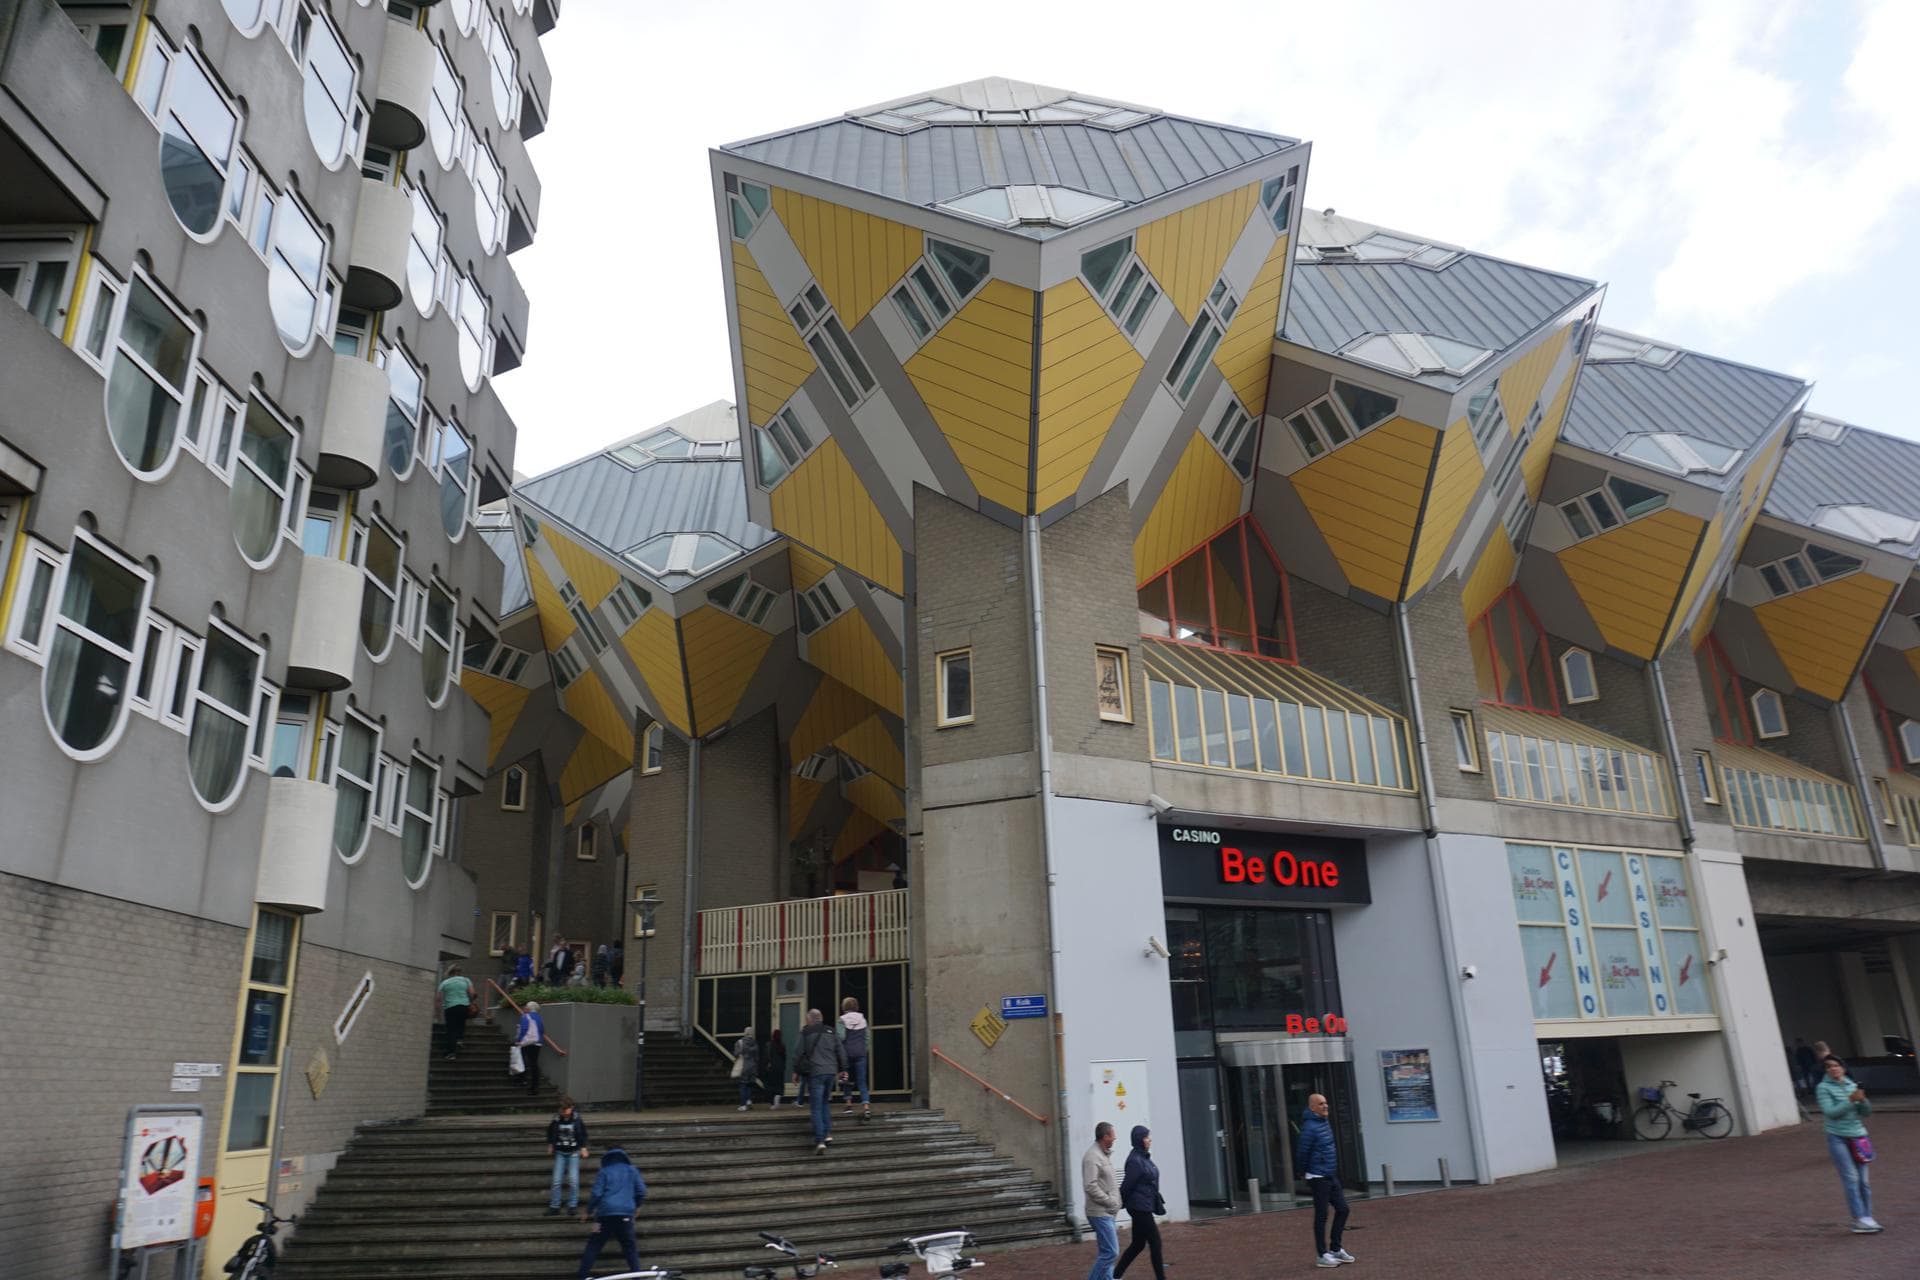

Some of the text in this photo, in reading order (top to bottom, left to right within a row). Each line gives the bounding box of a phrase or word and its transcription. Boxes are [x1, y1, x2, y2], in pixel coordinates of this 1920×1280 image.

[1173, 829, 1220, 844] CASINO
[1221, 848, 1339, 887] Be One
[1557, 852, 1595, 1013] CASINO
[1629, 858, 1666, 1011] CASINO
[1286, 1013, 1319, 1033] Be
